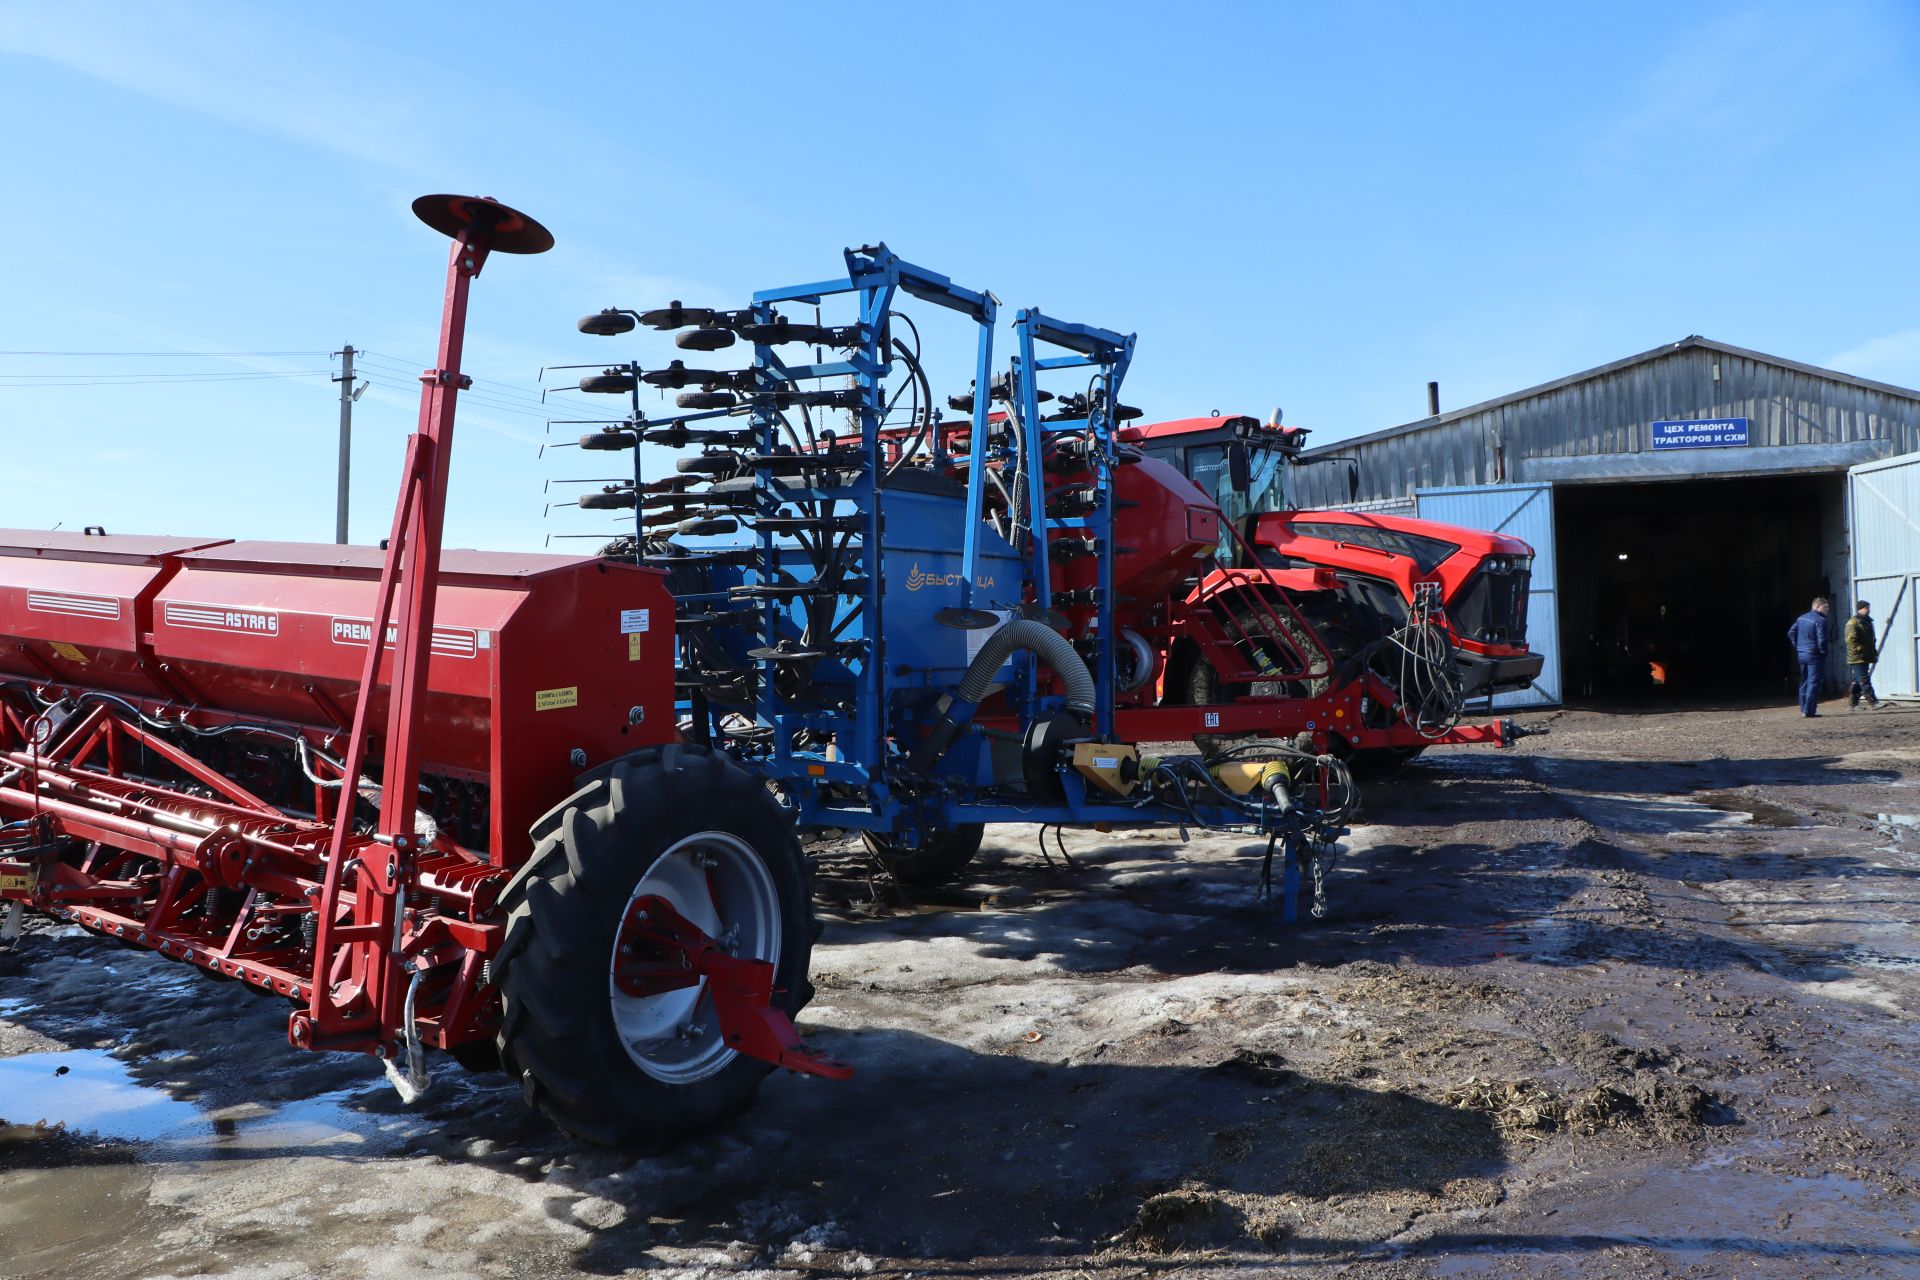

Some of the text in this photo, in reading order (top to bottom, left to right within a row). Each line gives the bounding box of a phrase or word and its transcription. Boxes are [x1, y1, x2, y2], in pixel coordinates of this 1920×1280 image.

[1664, 423, 1735, 433] ЦЕХ РЕМОНТА
[1654, 433, 1746, 445] ТРАКТОРОВ И СХМ
[225, 612, 277, 631] ASTRA 6
[334, 622, 398, 643] PREMM
